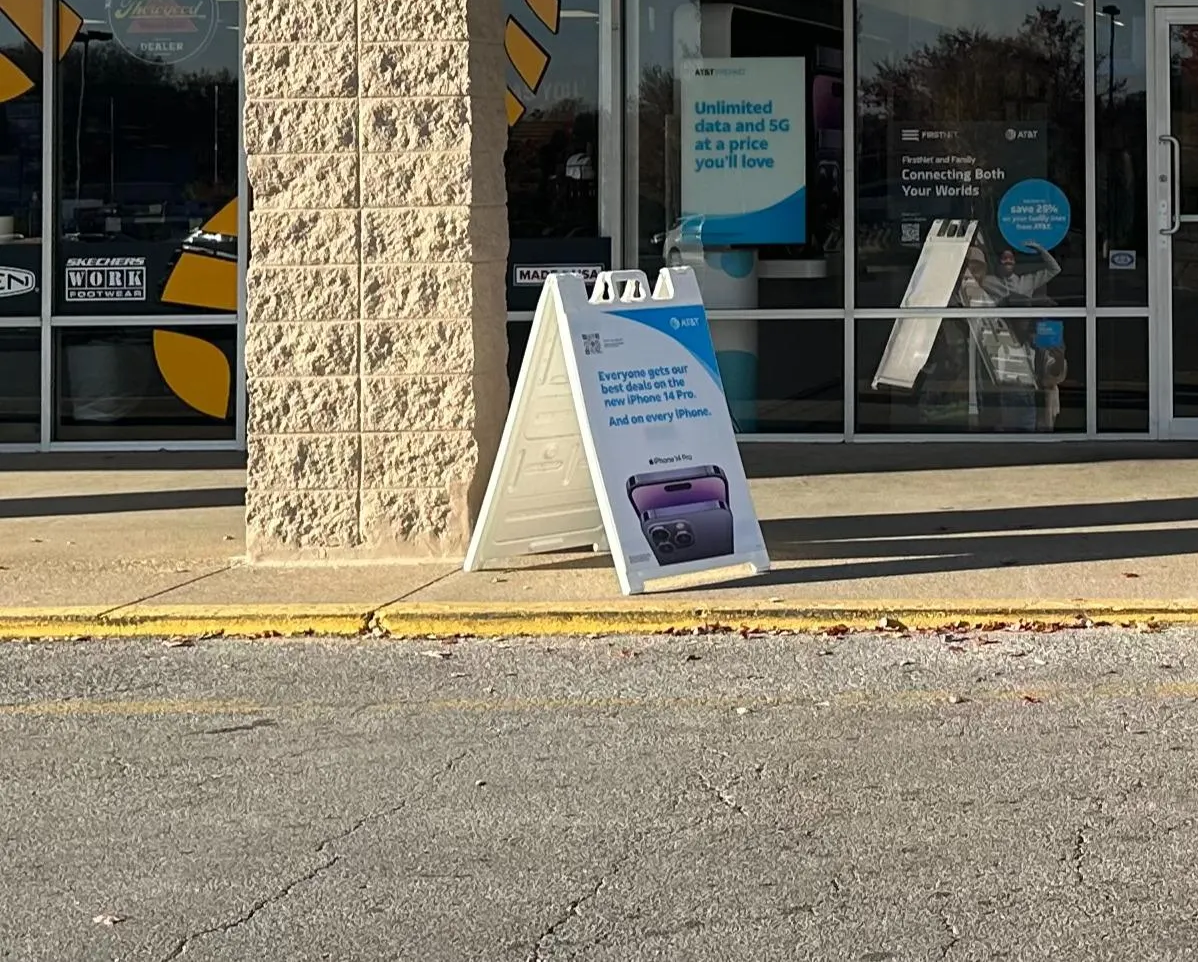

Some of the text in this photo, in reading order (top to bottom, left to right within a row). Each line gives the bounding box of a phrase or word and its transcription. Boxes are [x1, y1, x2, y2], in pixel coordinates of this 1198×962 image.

[140, 42, 184, 51] DEALER
[695, 100, 773, 114] Unlimited
[695, 118, 790, 132] data and 5G
[1018, 130, 1039, 139] AT&T
[695, 136, 769, 153] at a price
[695, 154, 775, 172] you'll love
[935, 156, 950, 164] and
[902, 168, 1005, 182] Connecting Both
[902, 185, 980, 197] Your Worlds
[66, 257, 146, 266] SKECHERS
[68, 270, 142, 287] WORK
[69, 290, 142, 298] FOOTWEAR
[681, 317, 700, 327] AT&T
[598, 365, 689, 382] Everyone gets our
[601, 376, 685, 394] best deals on the
[604, 389, 697, 408] new iPhone 14 Pro.
[609, 407, 712, 427] And on every iPhone.
